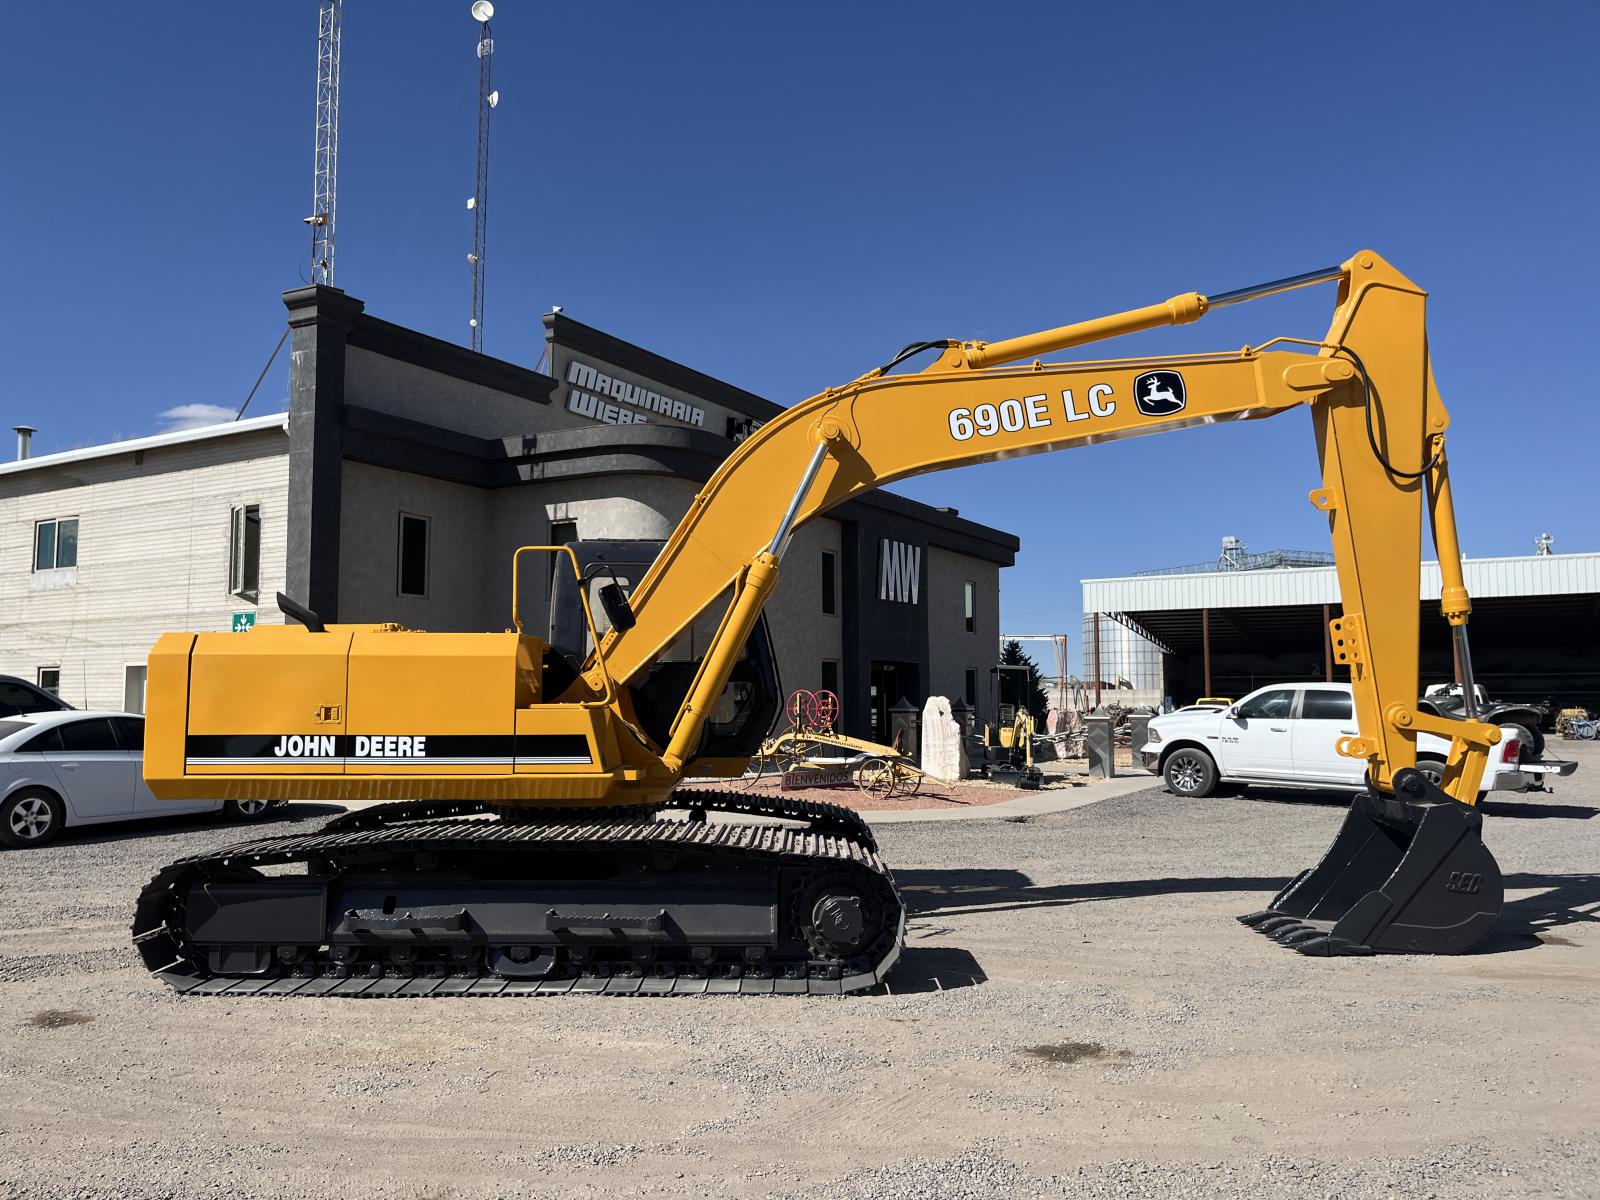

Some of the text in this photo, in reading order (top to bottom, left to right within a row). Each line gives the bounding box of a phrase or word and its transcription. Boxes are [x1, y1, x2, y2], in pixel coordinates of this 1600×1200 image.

[568, 360, 705, 427] MAQUINARIA
[948, 383, 1117, 441] 690E LC
[880, 538, 921, 605] MW
[274, 735, 426, 757] JOHN DEERE
[785, 771, 849, 786] BIENVENIDOS
